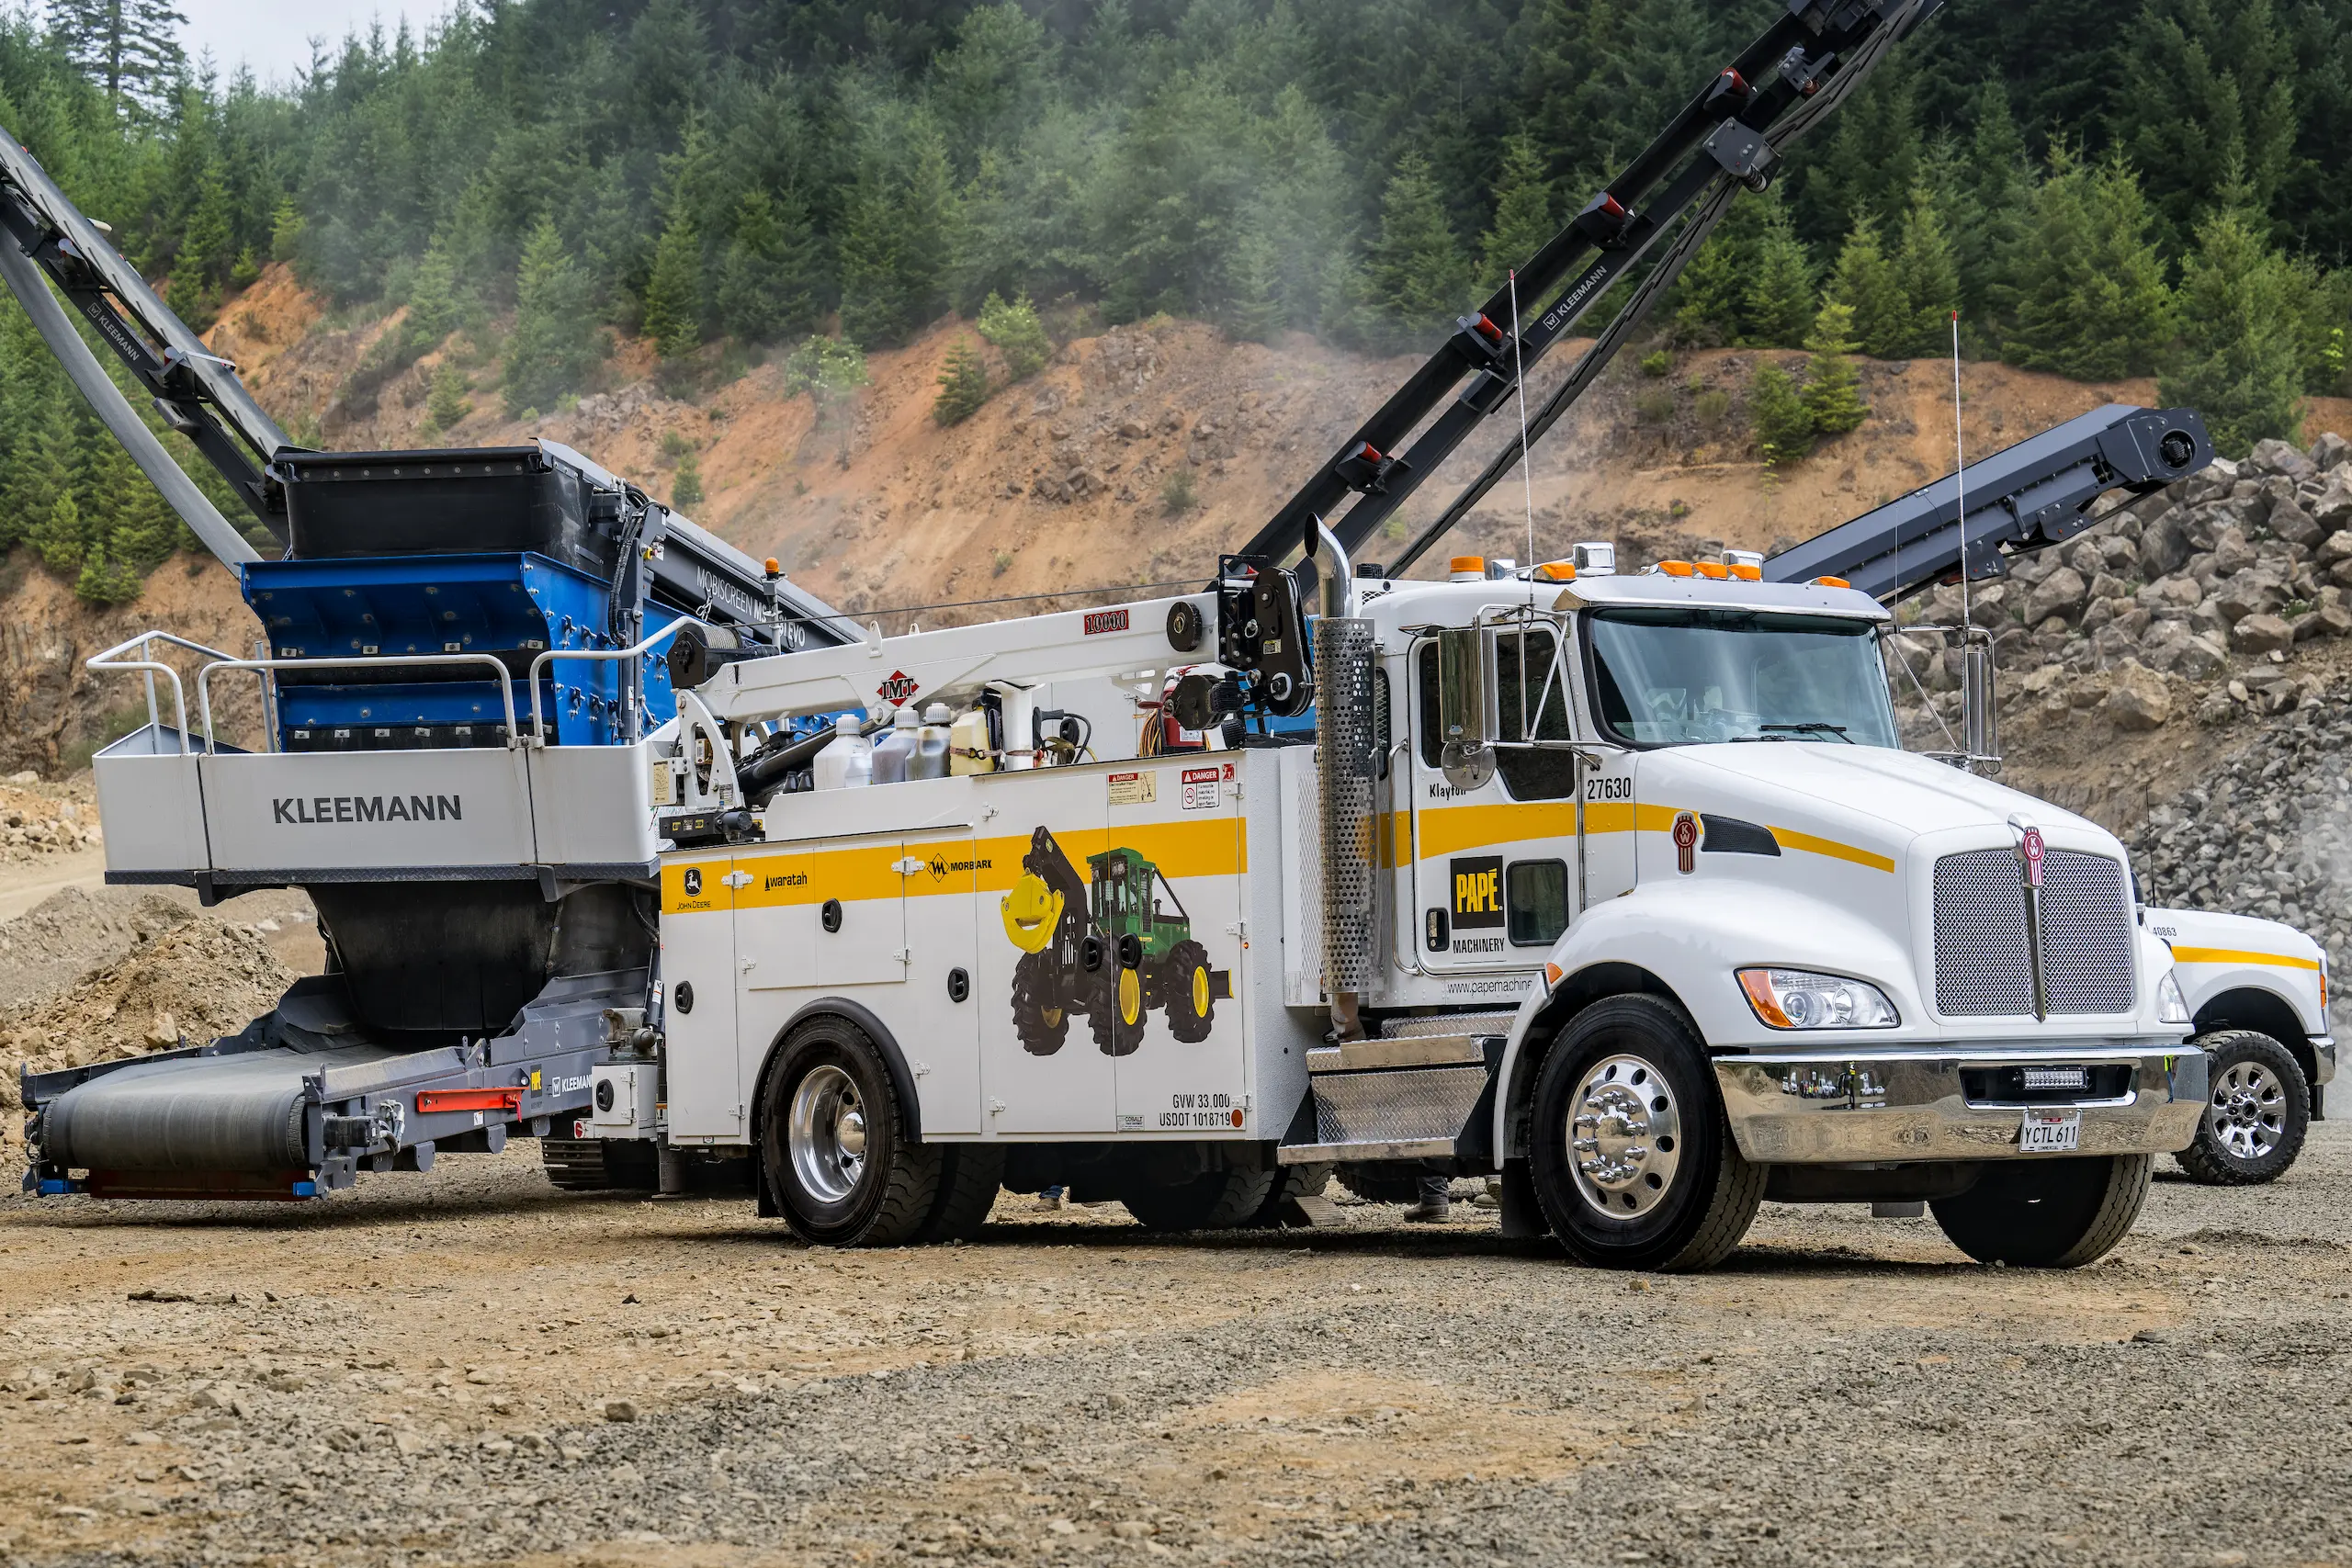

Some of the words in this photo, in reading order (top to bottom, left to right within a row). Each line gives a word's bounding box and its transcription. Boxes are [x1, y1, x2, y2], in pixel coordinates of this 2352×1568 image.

[1556, 265, 1608, 317] KLEEMANN
[98, 315, 140, 361] KLEEMANN
[696, 565, 753, 616] MOBISCREEN
[788, 621, 806, 648] EVO
[1086, 612, 1127, 634] 10000
[881, 677, 915, 701] IMT
[1115, 773, 1135, 782] DANGER
[1192, 771, 1217, 781] DANGER
[1587, 777, 1632, 800] 27630
[272, 795, 462, 823] KLEEMANN
[950, 859, 992, 872] MORBARK
[770, 871, 808, 887] waratah
[676, 901, 692, 910] JOHN
[692, 900, 711, 908] DEERE
[2153, 927, 2177, 937] 40863
[1453, 938, 1505, 954] MACHINERY
[1172, 1094, 1195, 1109] GVW
[1197, 1093, 1230, 1110] 33,000
[1159, 1112, 1190, 1126] USDOT
[1193, 1111, 1231, 1126] 1018719
[2025, 1125, 2076, 1145] YCTL611
